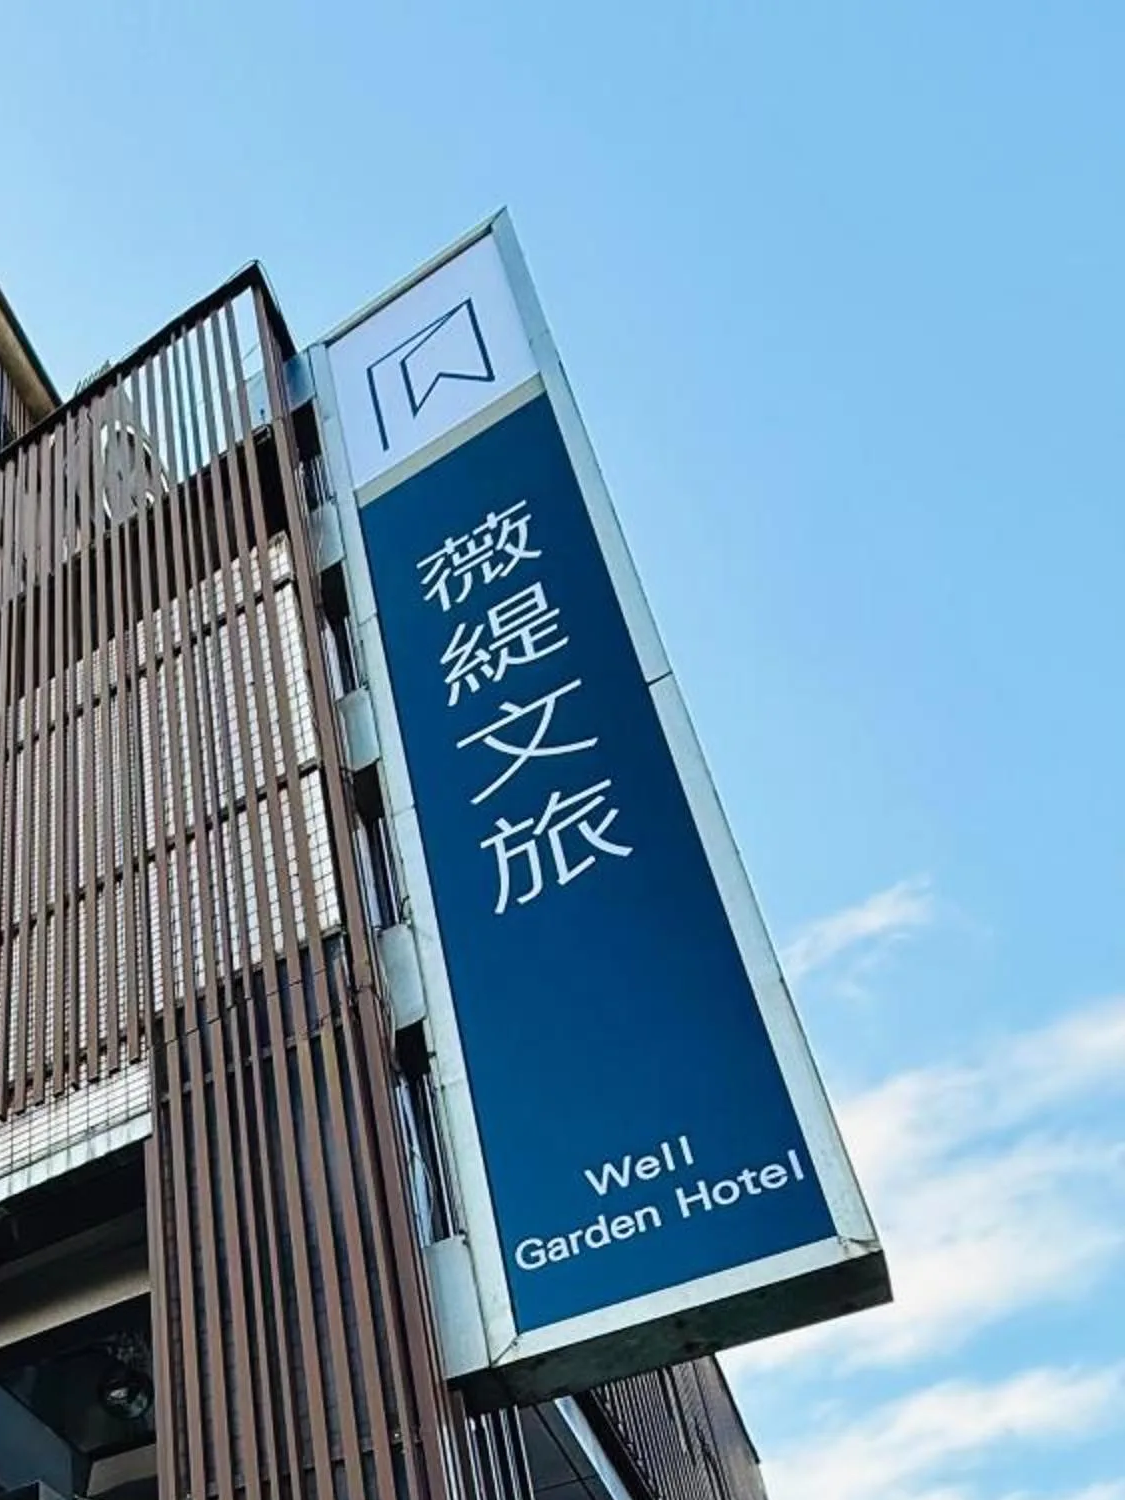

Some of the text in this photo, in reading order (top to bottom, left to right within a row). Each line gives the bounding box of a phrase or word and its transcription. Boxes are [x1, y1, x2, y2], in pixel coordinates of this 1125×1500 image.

[416, 500, 632, 913] 薇緹文旅
[515, 1150, 804, 1270] Garden Hotel
[584, 1135, 694, 1196] Well
